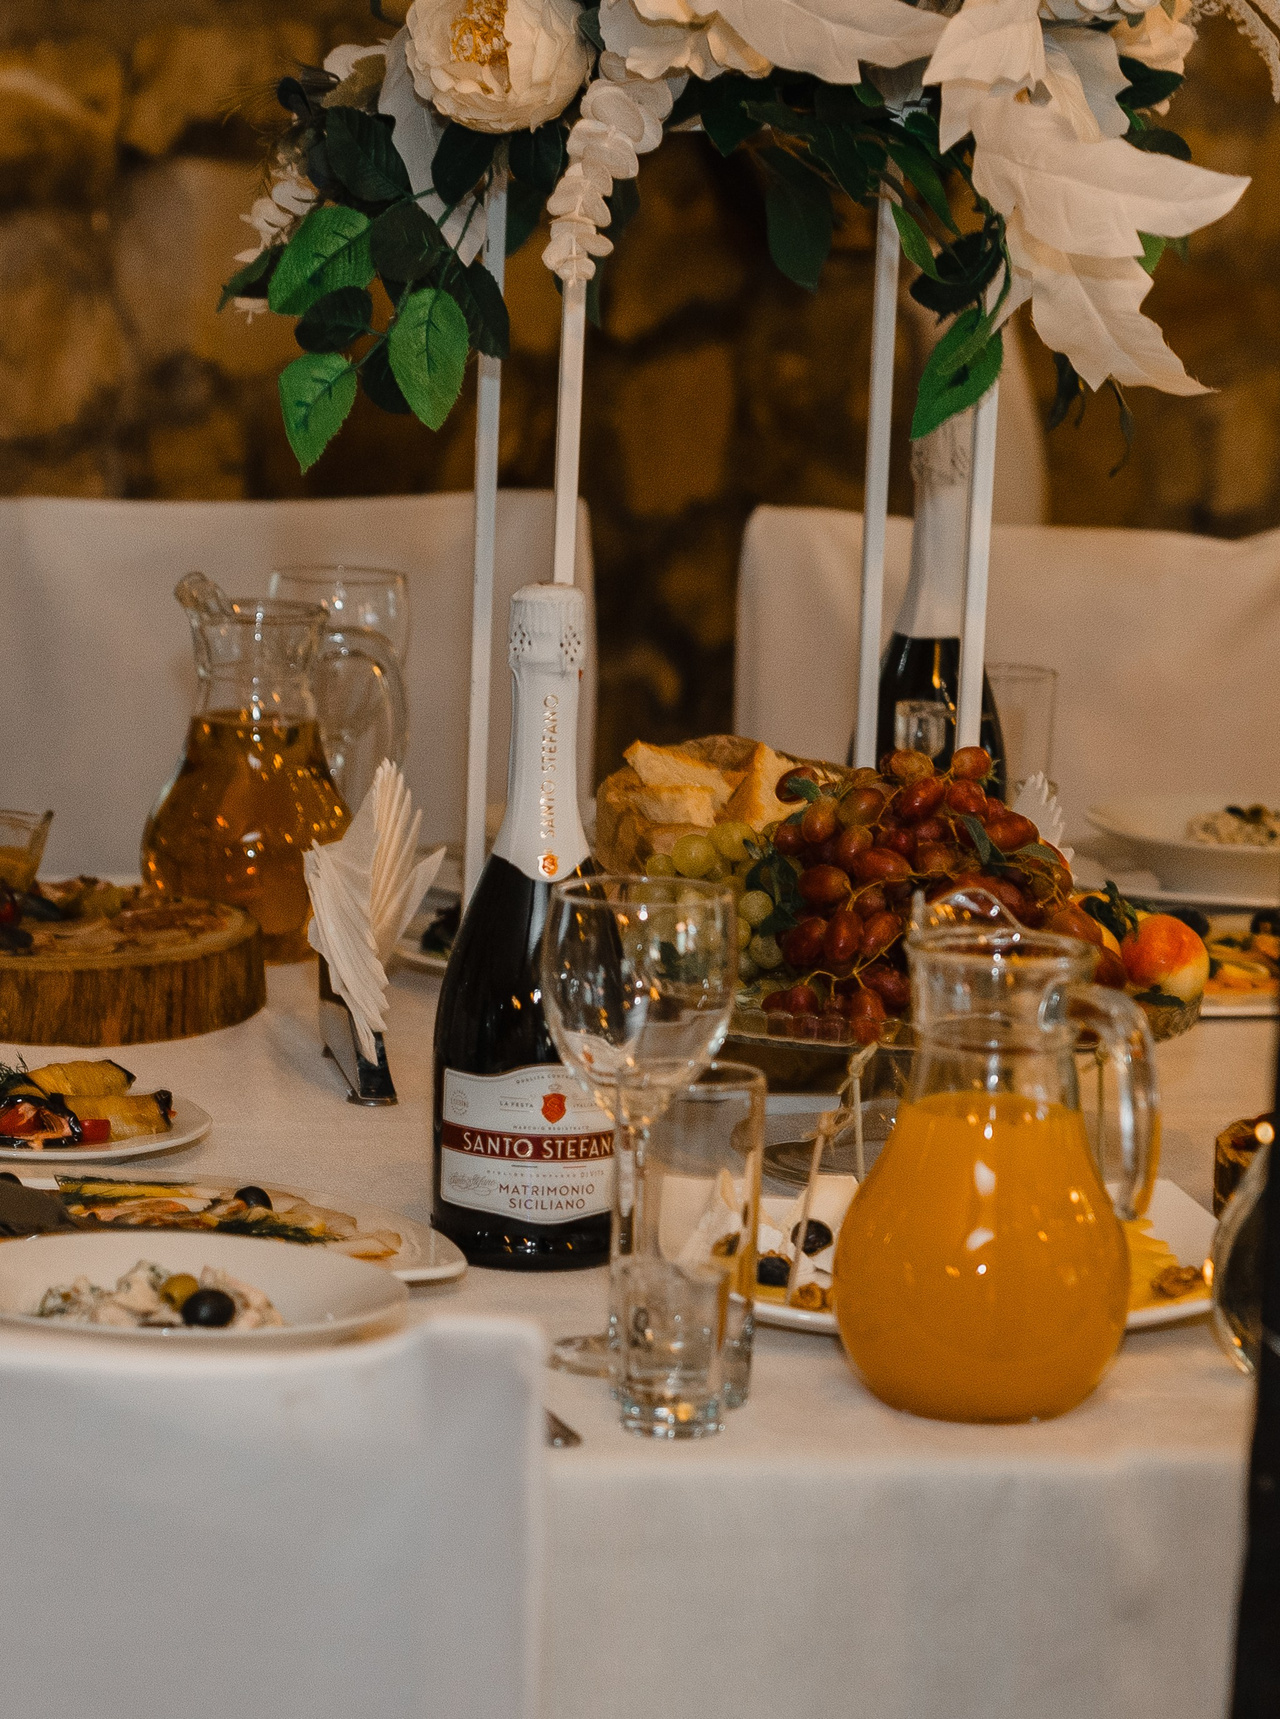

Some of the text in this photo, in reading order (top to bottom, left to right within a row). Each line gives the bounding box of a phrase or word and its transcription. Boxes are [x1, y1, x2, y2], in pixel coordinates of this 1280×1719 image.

[540, 694, 559, 839] SANTO STEFANO
[463, 1131, 614, 1159] SANTO STEFAN
[498, 1183, 595, 1196] MATRIMONIO
[508, 1198, 586, 1211] SICILIANO
